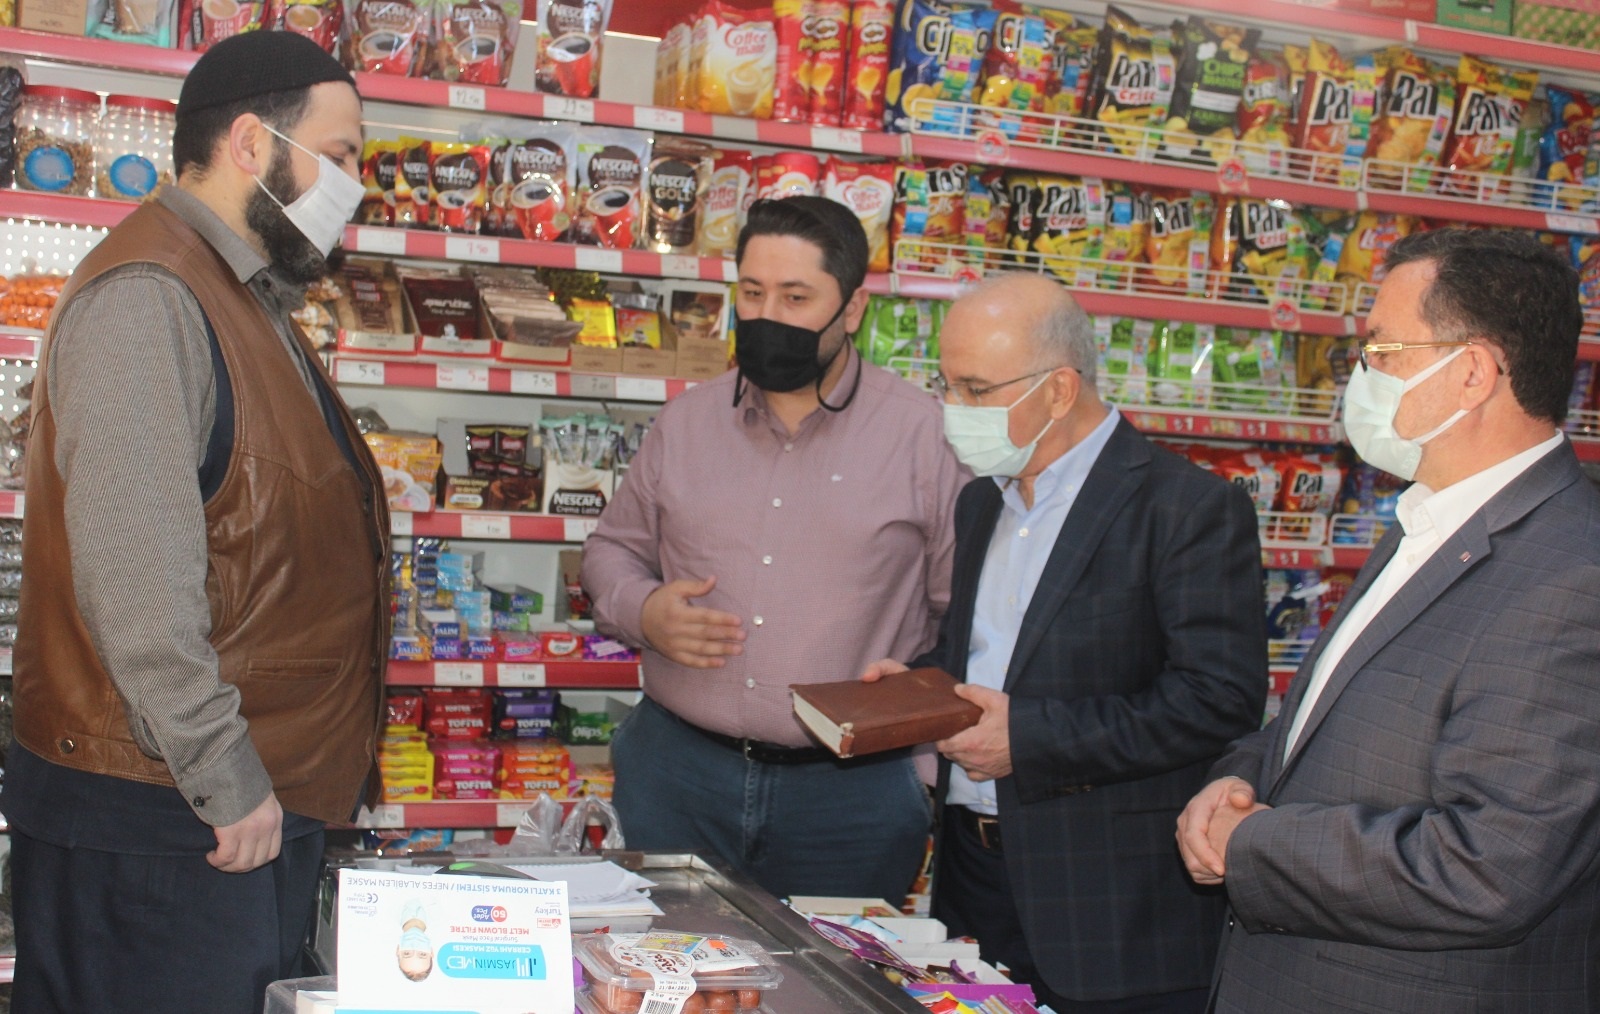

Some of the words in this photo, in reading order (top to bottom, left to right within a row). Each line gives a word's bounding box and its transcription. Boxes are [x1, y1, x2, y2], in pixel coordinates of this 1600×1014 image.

[725, 28, 767, 48] Coffee
[1388, 70, 1440, 120] Pat
[1455, 86, 1523, 136] Pats
[513, 150, 564, 168] NESCAFÉ
[591, 156, 640, 174] NESCAFÉ
[553, 492, 603, 508] NESCAFÉ
[347, 877, 377, 885] MASKE
[379, 879, 420, 889] ALABİLEN
[423, 881, 449, 890] NEFES
[456, 883, 489, 893] SİSTEMİ
[492, 885, 529, 893] KORUMA
[530, 886, 555, 894] KATLI
[492, 909, 506, 918] 50
[535, 906, 562, 915] Turkey
[478, 926, 508, 934] BLOWN
[509, 927, 530, 935] MELT
